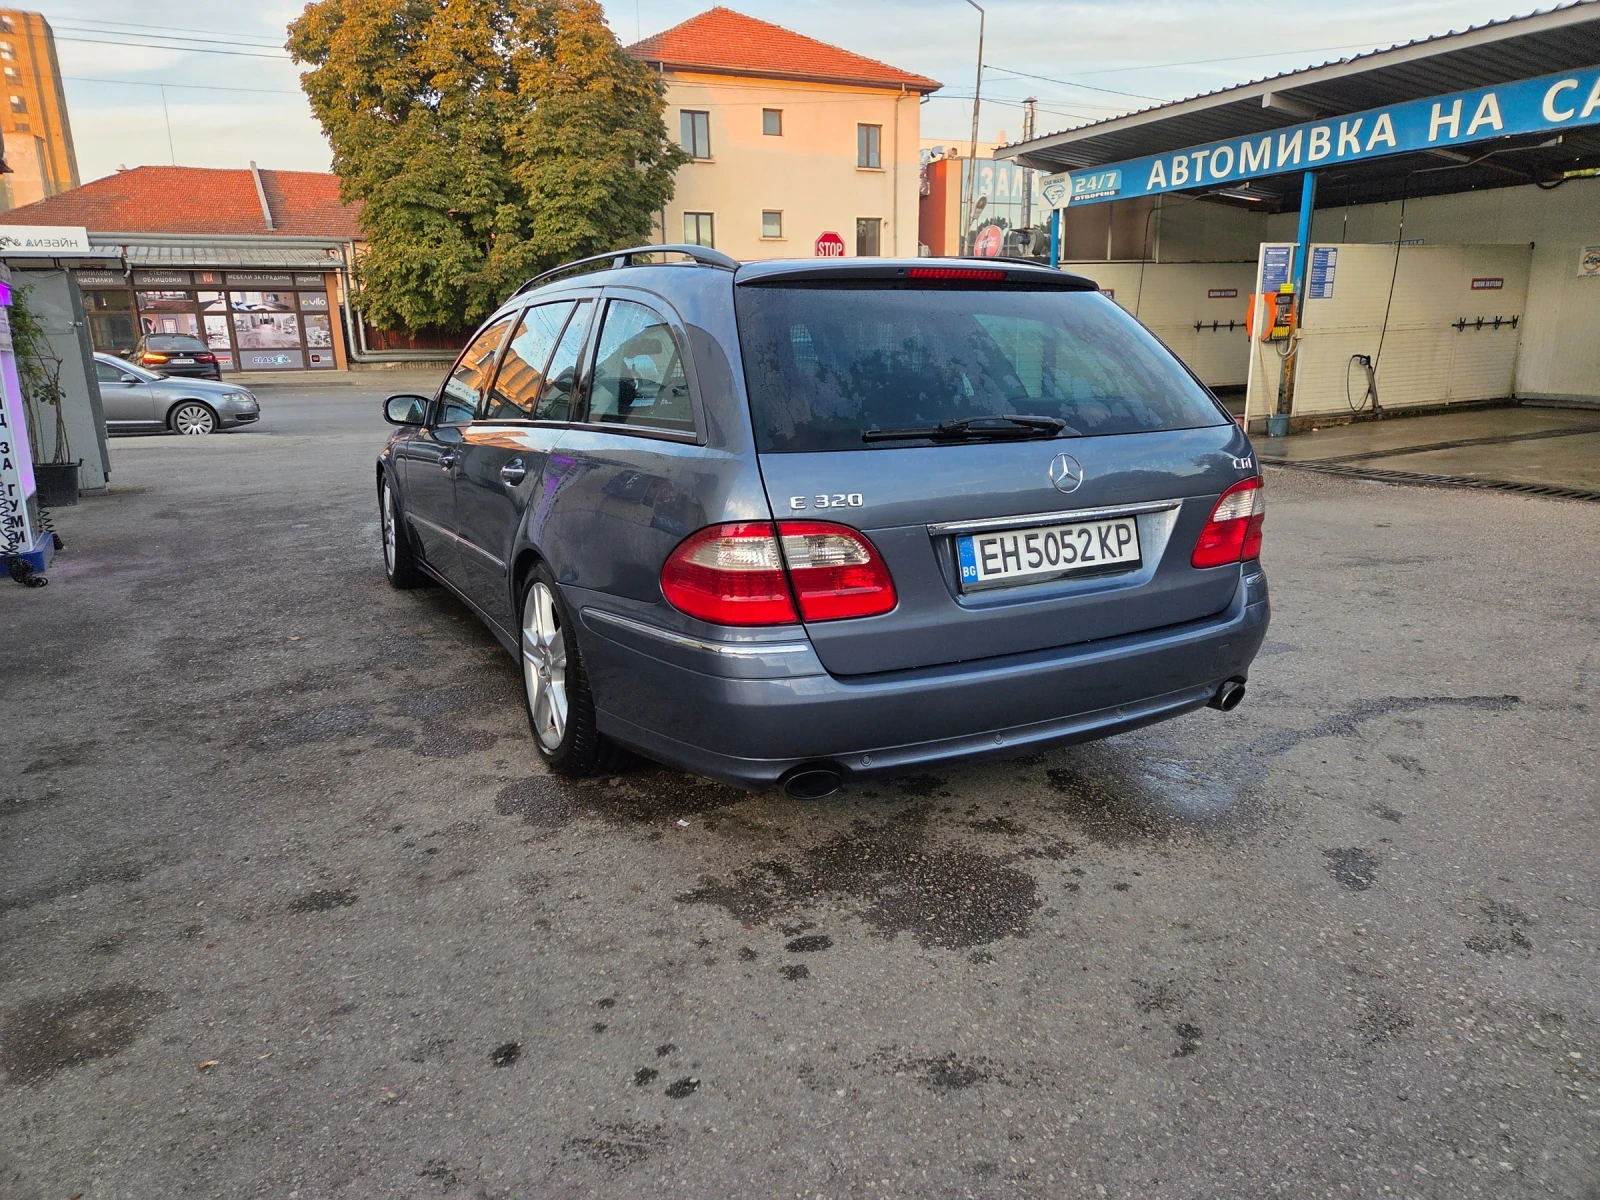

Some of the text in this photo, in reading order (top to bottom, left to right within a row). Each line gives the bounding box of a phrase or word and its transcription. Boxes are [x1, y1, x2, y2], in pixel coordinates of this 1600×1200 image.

[1146, 113, 1397, 191] АВТОМИВКА
[1428, 92, 1504, 142] НА
[1075, 172, 1117, 193] 24/7
[1074, 190, 1115, 201] ОТВОРЕНО
[818, 241, 843, 256] STOP
[309, 297, 326, 306] vilo
[253, 355, 288, 364] CLASSEN
[790, 493, 863, 509] E 320
[962, 565, 976, 577] BG
